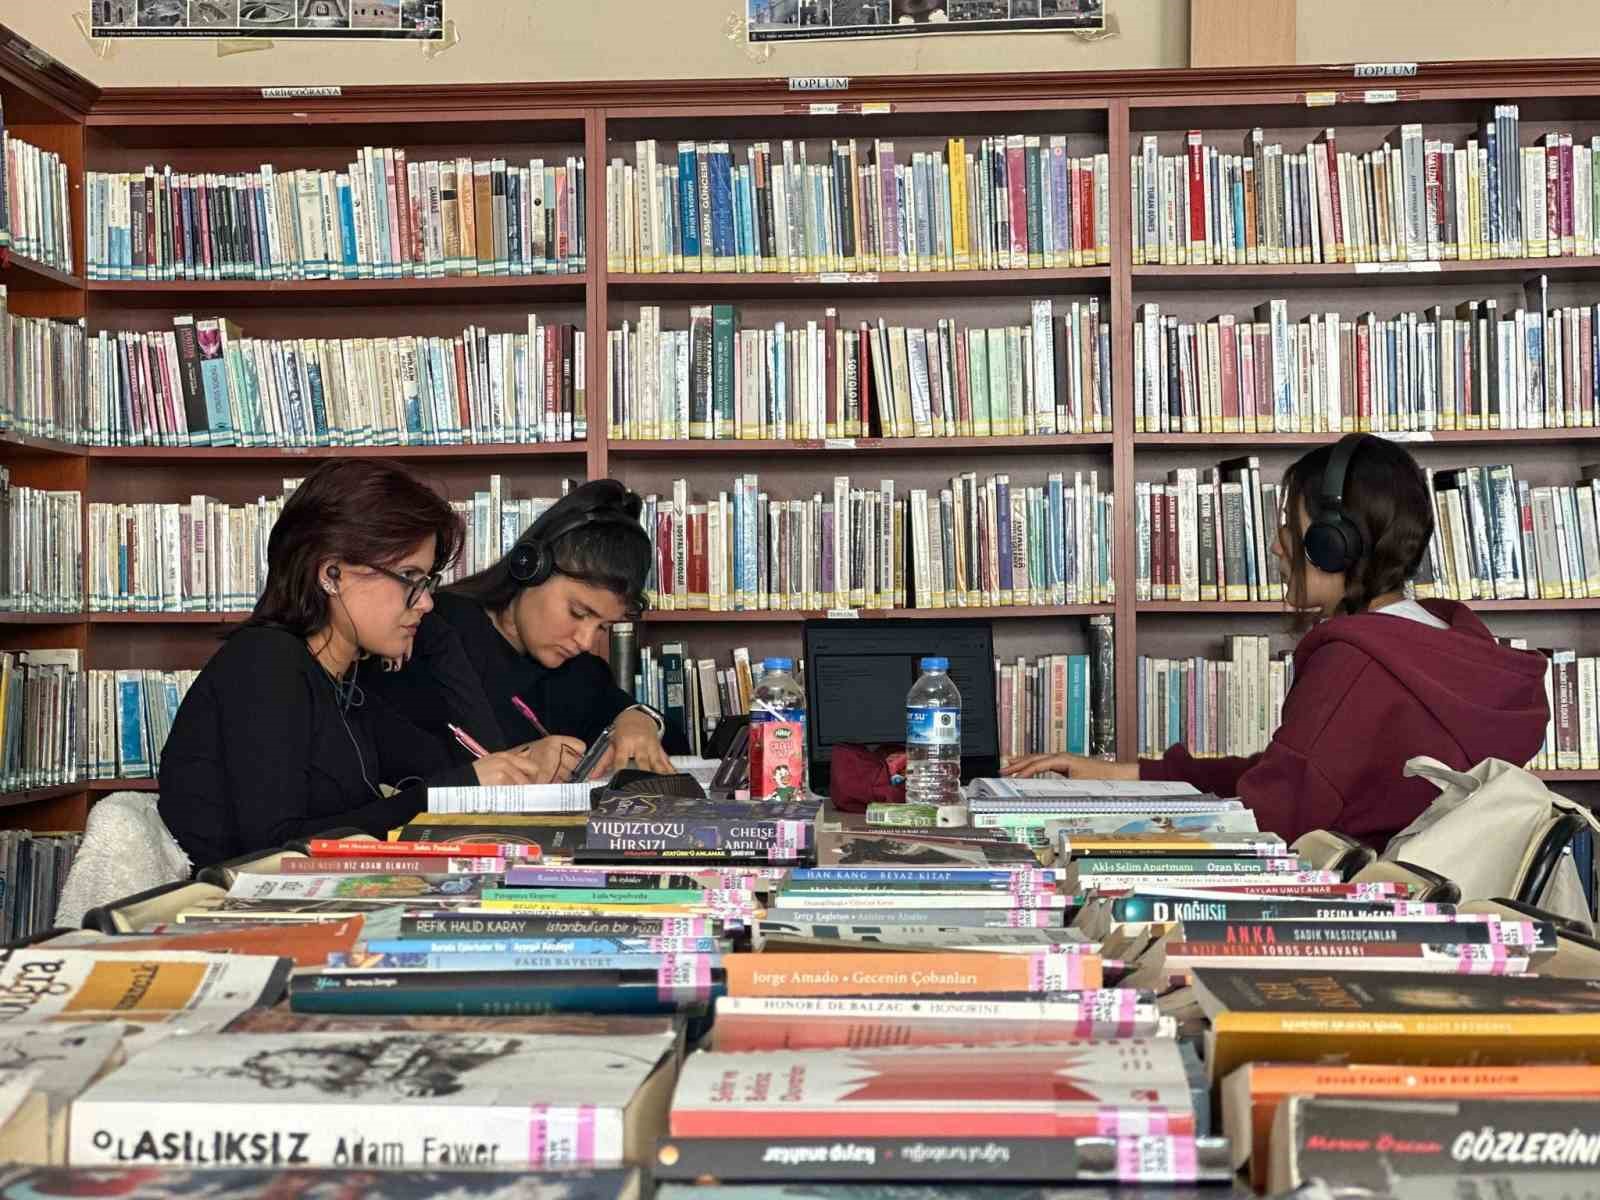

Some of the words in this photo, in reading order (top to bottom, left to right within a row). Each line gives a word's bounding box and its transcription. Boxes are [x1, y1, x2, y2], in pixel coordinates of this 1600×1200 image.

[1357, 65, 1416, 76] TOPLUM
[791, 79, 848, 89] TOPLUM
[700, 160, 711, 208] GÜNCESİ
[703, 212, 713, 247] BASIN
[847, 358, 858, 407] SOSYOLOJİ
[591, 821, 685, 837] YILDIZTOZU
[724, 840, 779, 850] ABDULLA
[1113, 862, 1141, 873] Selim
[1207, 862, 1235, 873] Ozan
[836, 871, 868, 880] KANG
[880, 871, 914, 880] BEYAZ
[1244, 887, 1279, 895] TAYLAN
[416, 920, 447, 933] REFİK
[451, 920, 484, 933] HALİD
[487, 920, 527, 933] KARAY
[612, 921, 631, 933] bir
[1226, 925, 1276, 944] ANKA
[1293, 929, 1323, 941] SADIK
[1262, 945, 1300, 956] TOROS
[752, 971, 786, 986] Jorge
[791, 971, 839, 983] Amado
[852, 971, 908, 983] Gecenin
[911, 971, 977, 986] Çobanları
[763, 1000, 823, 1010] HONORÉ
[828, 1001, 845, 1010] DE
[849, 1002, 903, 1012] BALZAC
[93, 1130, 311, 1163] OLASILIKSIZ
[333, 1136, 405, 1166] Adam
[422, 1136, 501, 1166] Fawer
[1451, 1125, 1600, 1164] GÖZLERİN
